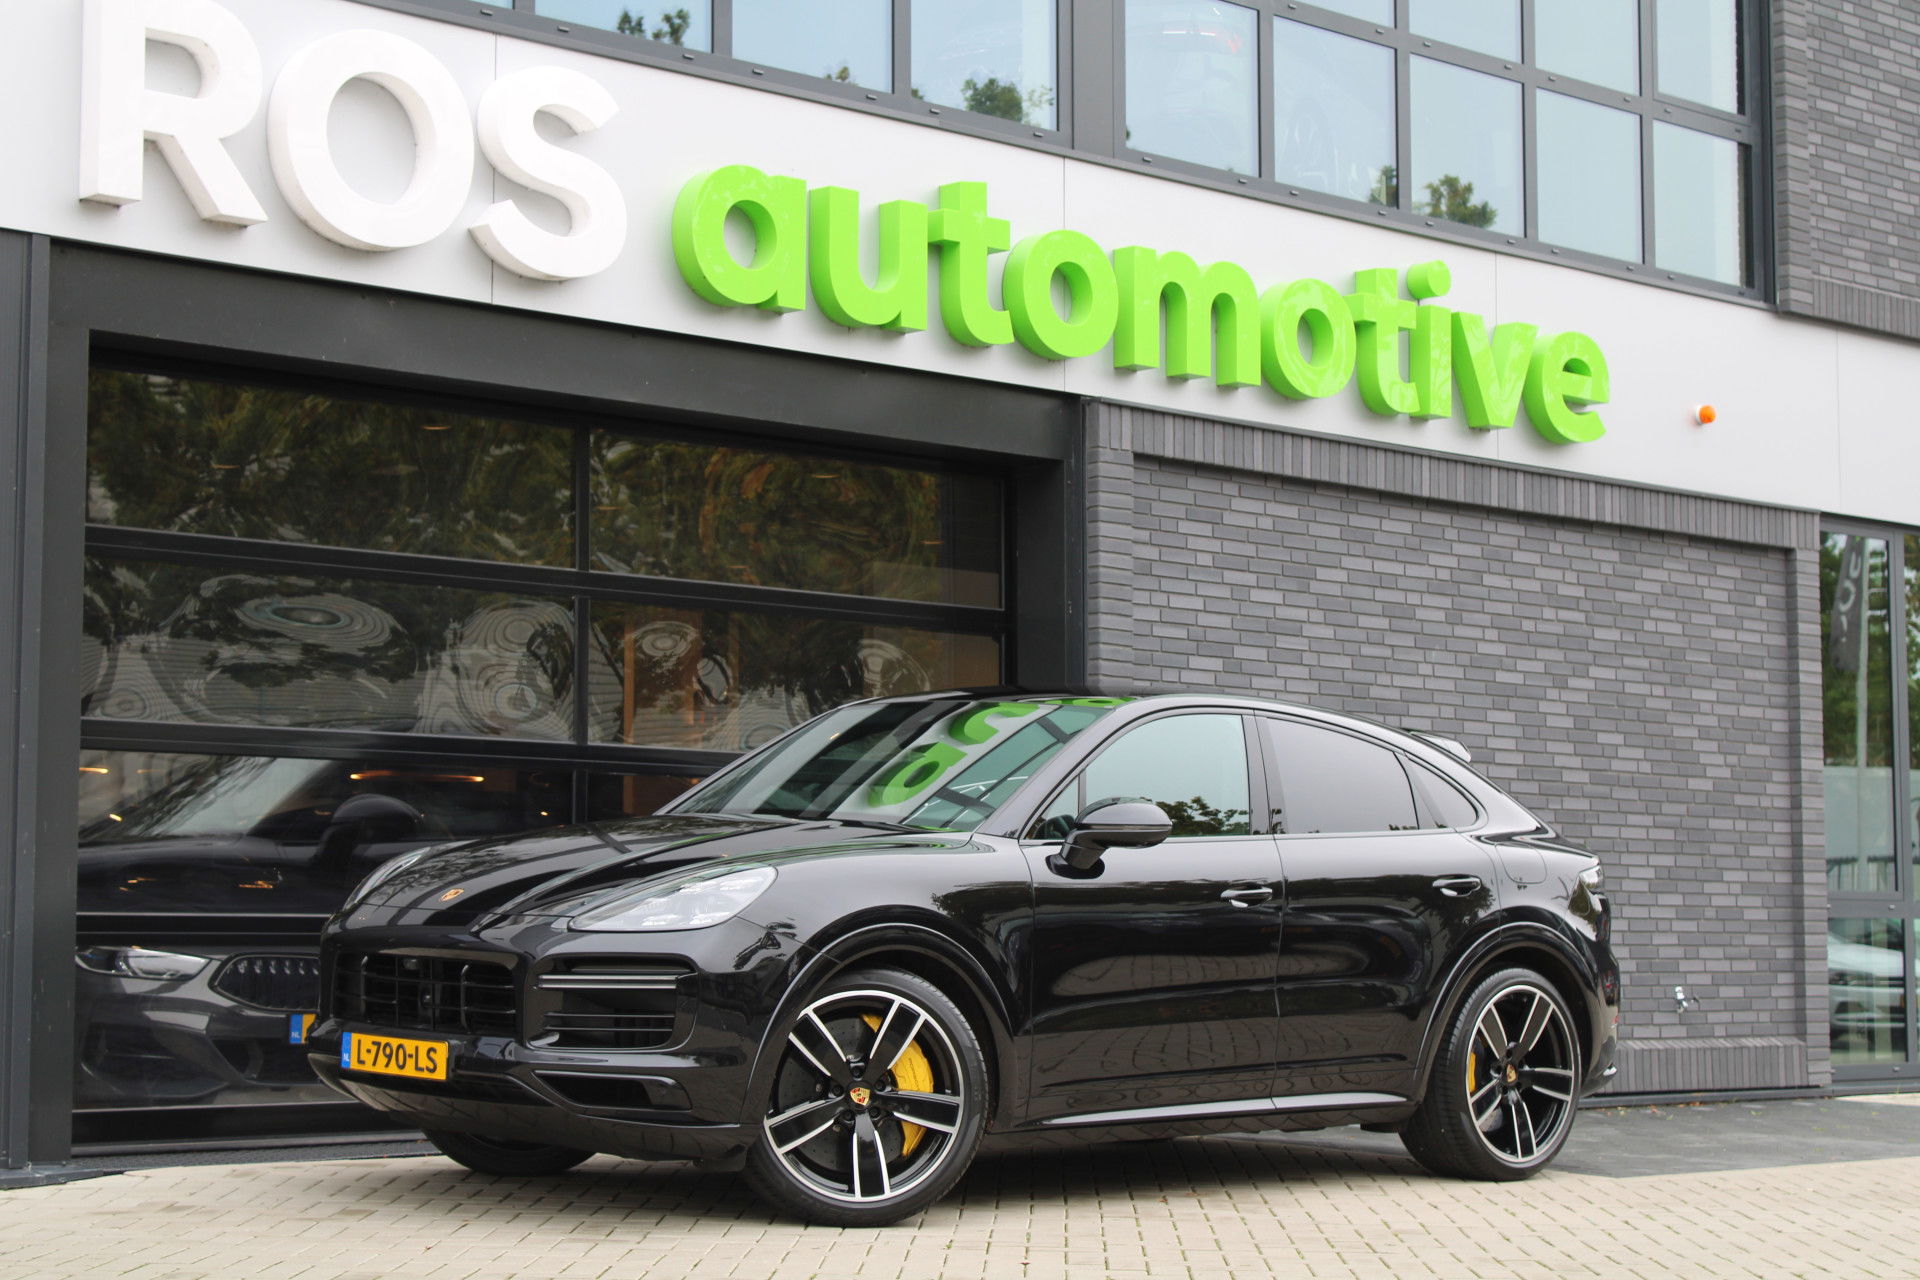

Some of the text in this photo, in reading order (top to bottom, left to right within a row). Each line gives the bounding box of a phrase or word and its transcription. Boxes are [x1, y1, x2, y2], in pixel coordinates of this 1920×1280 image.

[79, 0, 1609, 443] ROS automotive
[357, 1039, 438, 1073] L-790-LS
